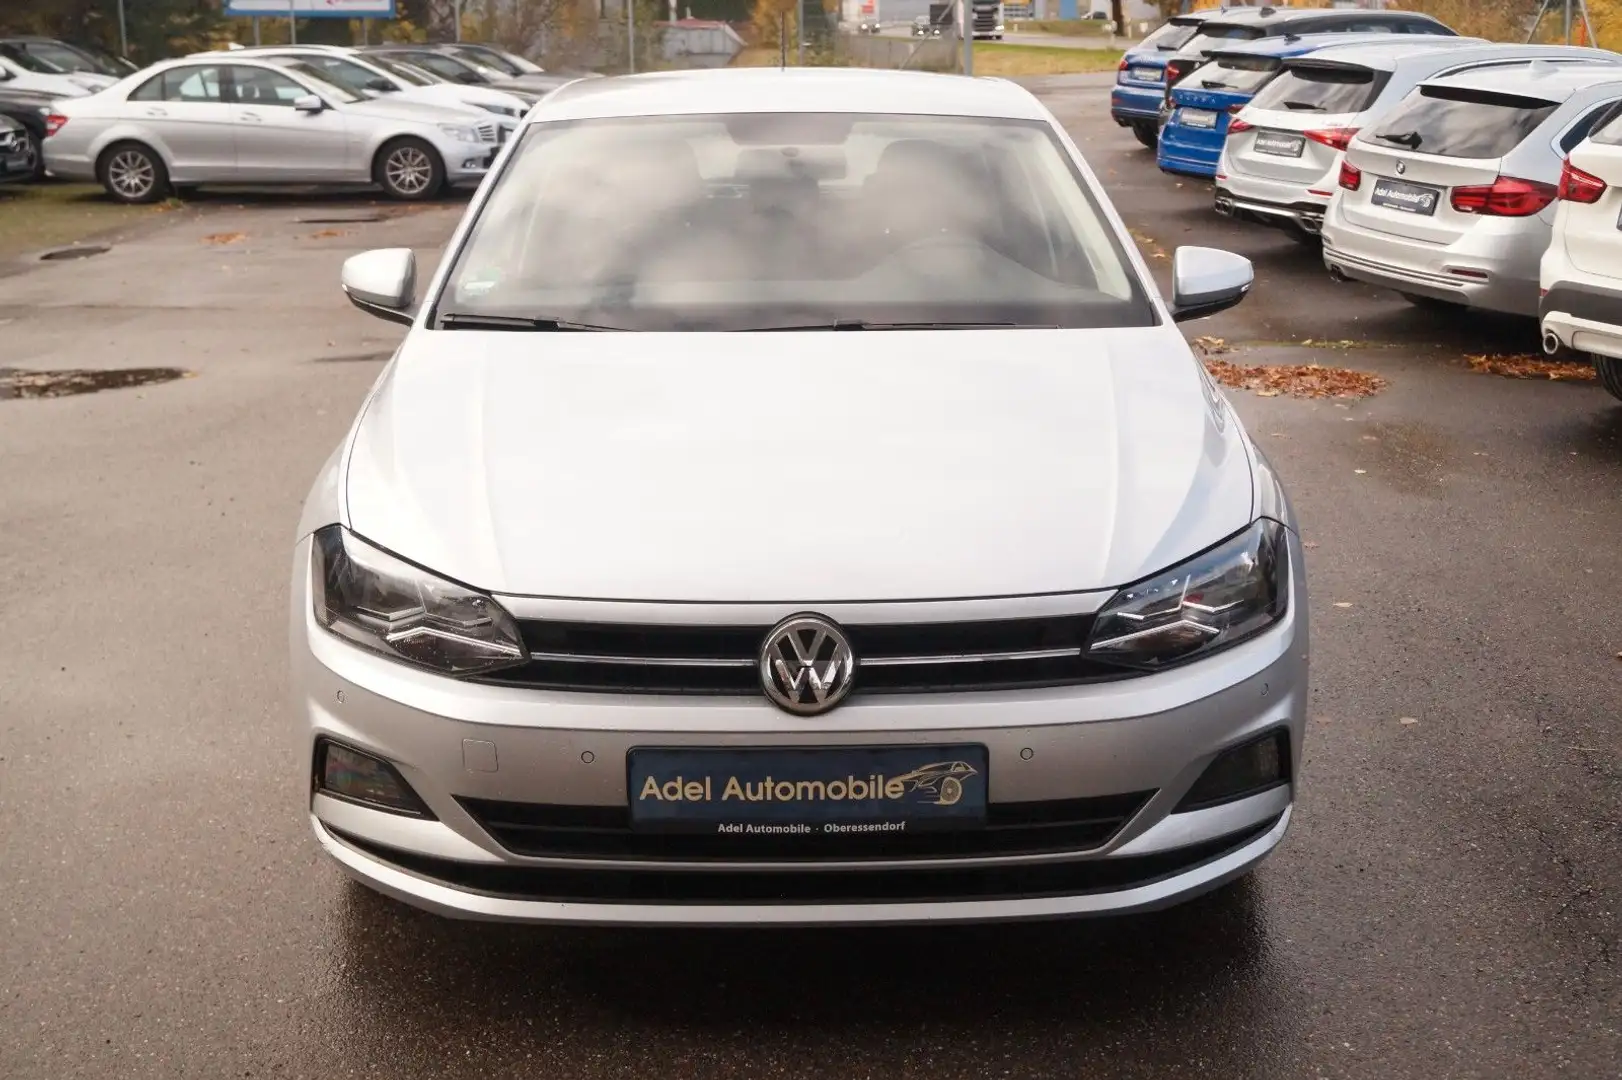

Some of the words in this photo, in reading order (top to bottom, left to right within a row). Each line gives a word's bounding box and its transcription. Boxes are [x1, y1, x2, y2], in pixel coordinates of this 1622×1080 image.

[639, 775, 711, 801] Adel
[721, 775, 905, 801] Automobile
[717, 823, 744, 833] Adel
[745, 823, 811, 834] Automobile
[823, 821, 906, 834] Oberessendorf
